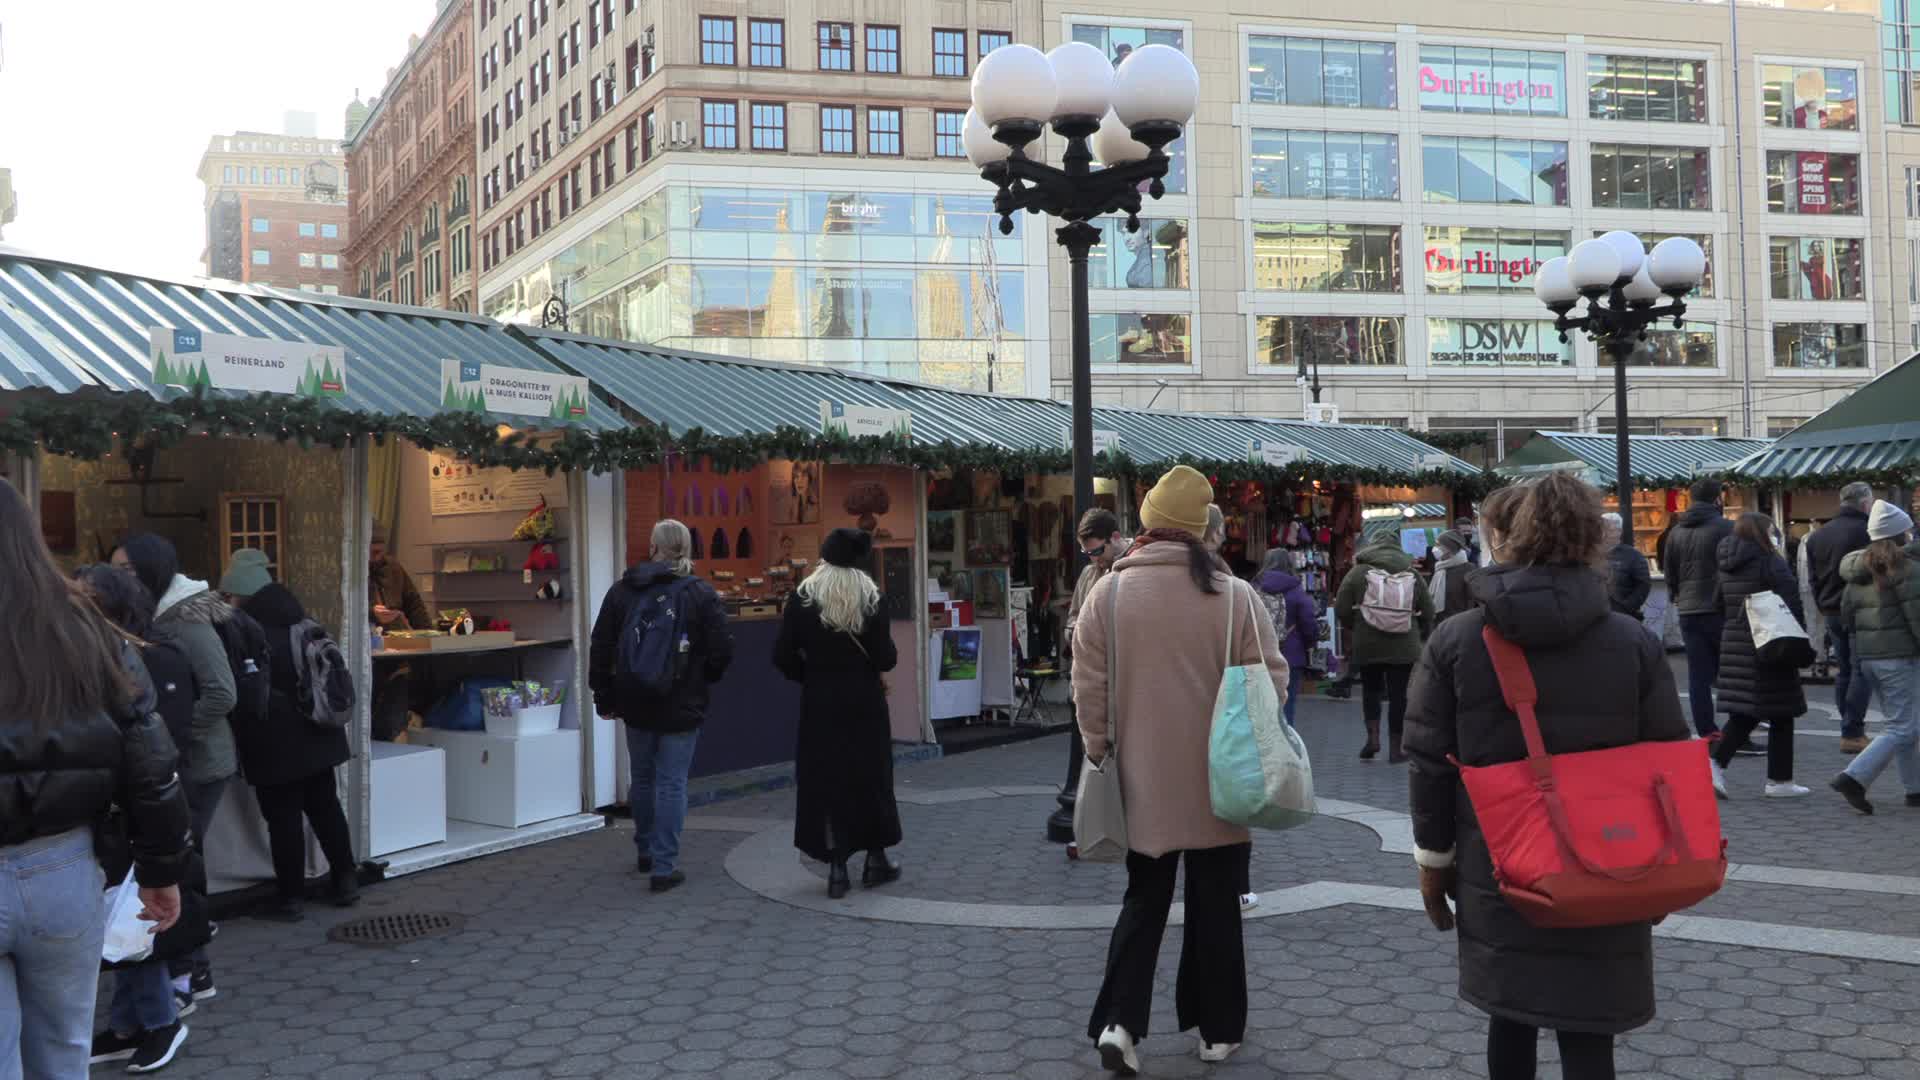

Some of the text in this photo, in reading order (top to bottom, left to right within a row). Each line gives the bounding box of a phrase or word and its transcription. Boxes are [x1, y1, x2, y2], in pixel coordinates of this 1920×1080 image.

[1419, 66, 1553, 105] Burlington
[1425, 247, 1543, 283] Burlingt
[178, 337, 196, 346] C13
[1459, 322, 1530, 350] DSW
[224, 355, 285, 369] REINERLAND
[1476, 353, 1501, 362] SHOE
[490, 378, 540, 391] DRAGONETTE
[496, 390, 517, 399] MUSE
[519, 392, 553, 402] KALLIOPE
